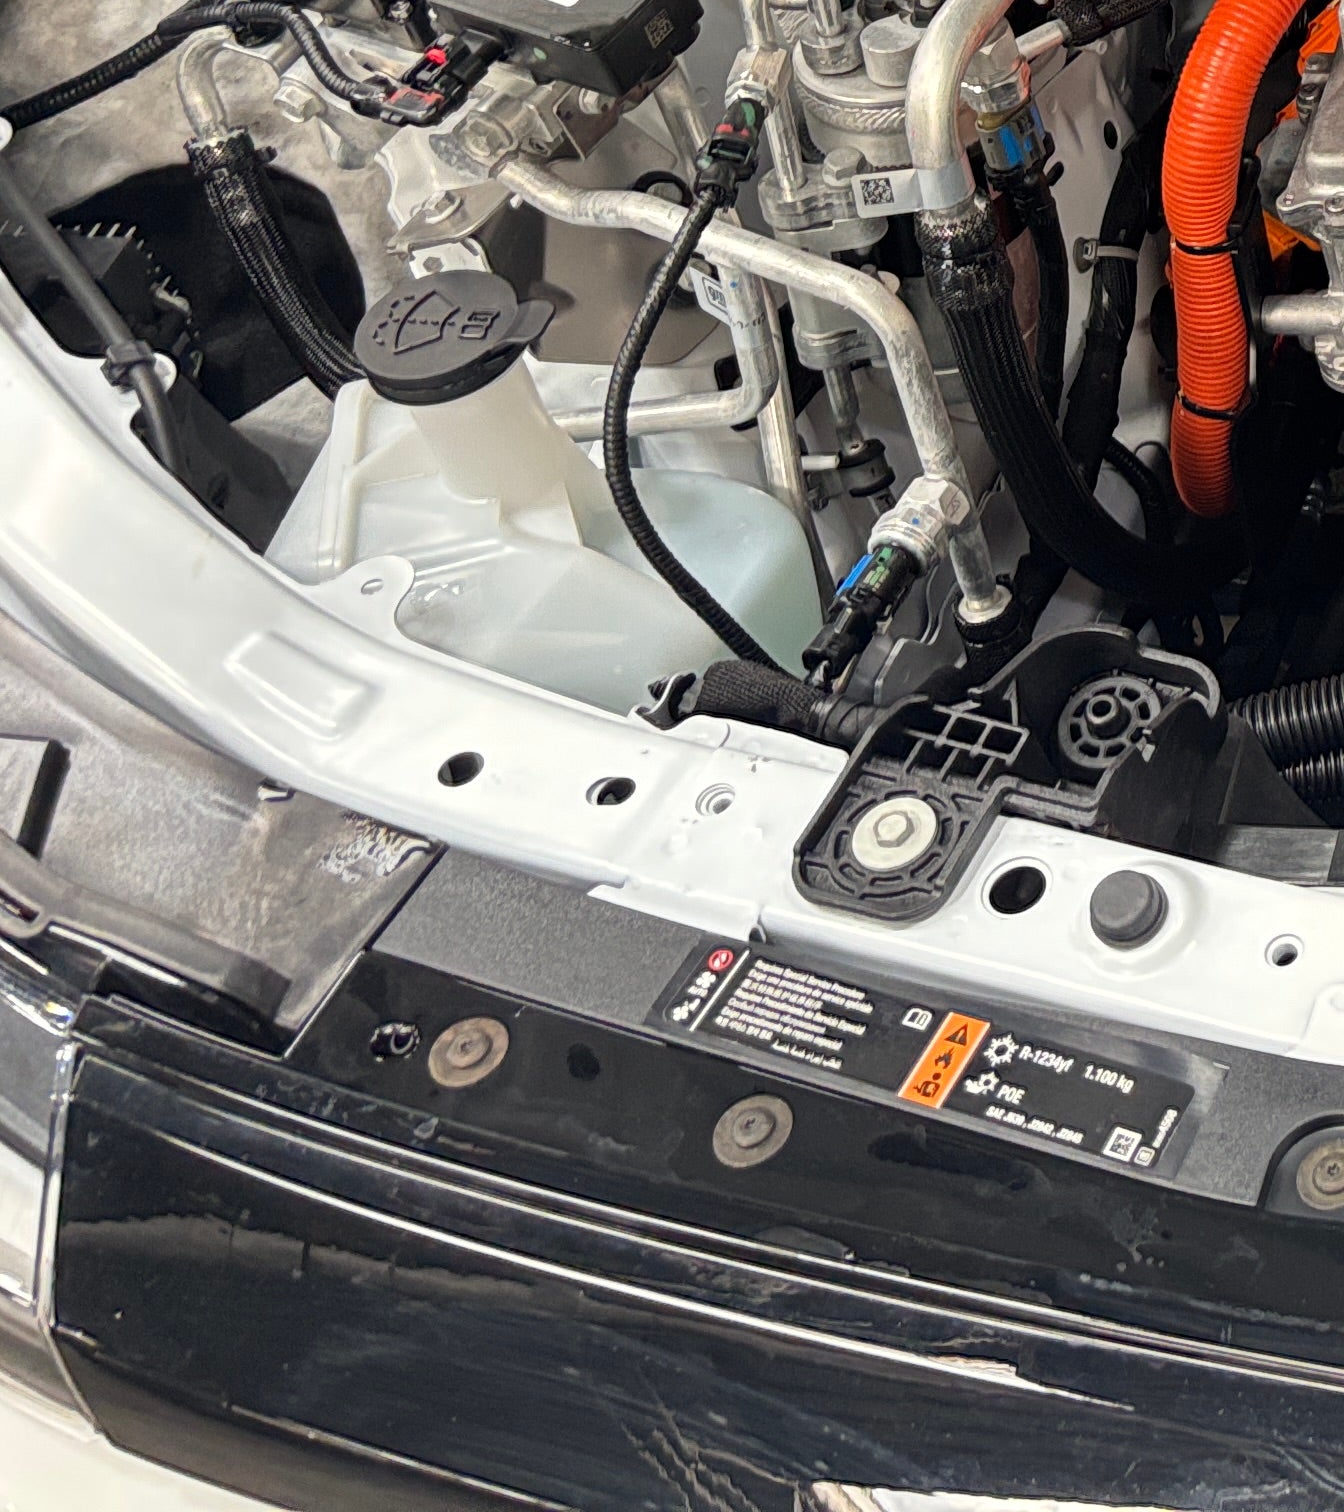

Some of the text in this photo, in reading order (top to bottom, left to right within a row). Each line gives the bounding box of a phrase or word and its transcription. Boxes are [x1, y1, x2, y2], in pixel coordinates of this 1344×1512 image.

[1019, 1045, 1135, 1094] R-1234yf 1.100 kg
[996, 1085, 1026, 1105] POE
